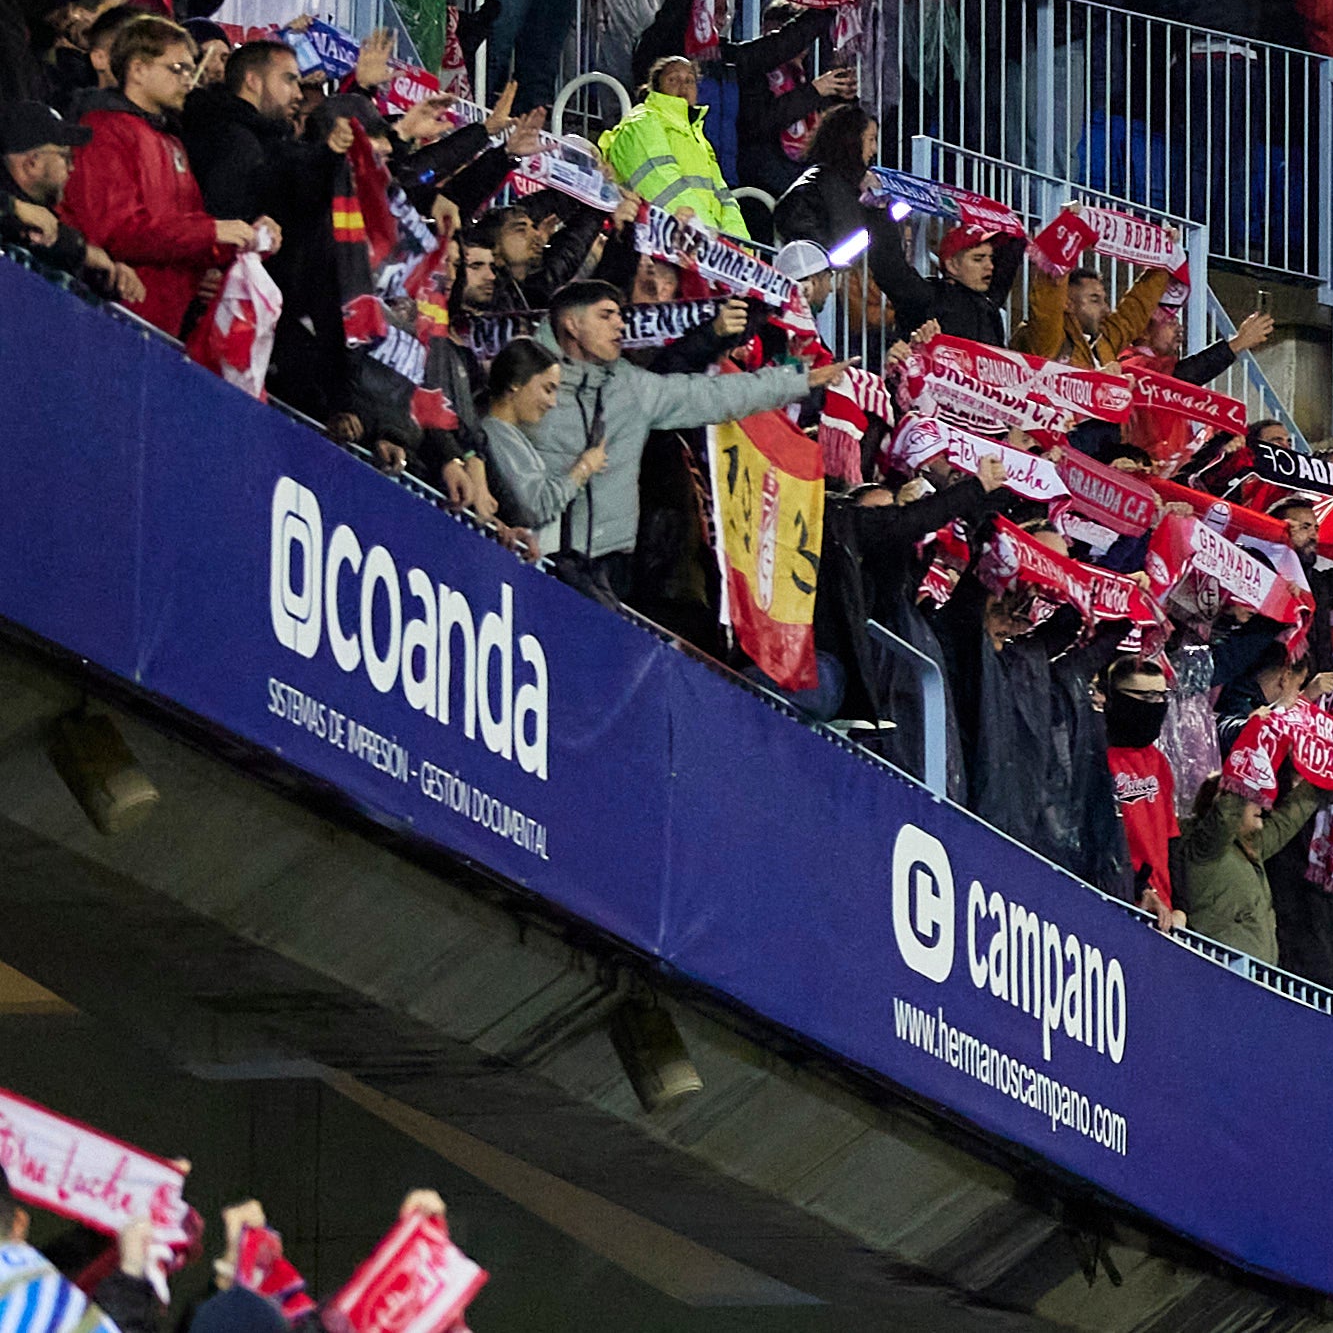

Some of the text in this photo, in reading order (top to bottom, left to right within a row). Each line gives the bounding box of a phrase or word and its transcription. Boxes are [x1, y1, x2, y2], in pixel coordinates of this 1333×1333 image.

[1067, 465, 1121, 509] GRANADA
[1199, 533, 1263, 587] GRANADA
[324, 524, 548, 781] coanda
[268, 677, 326, 738] SISTEMAS
[328, 708, 346, 751] DE
[347, 719, 408, 783] IMPRESIÓN
[420, 761, 470, 813] GESTIÓN
[472, 786, 549, 860] DOCUMENTAL
[967, 880, 1127, 1064] campano
[894, 997, 1127, 1156] www.hermanoscampano.com
